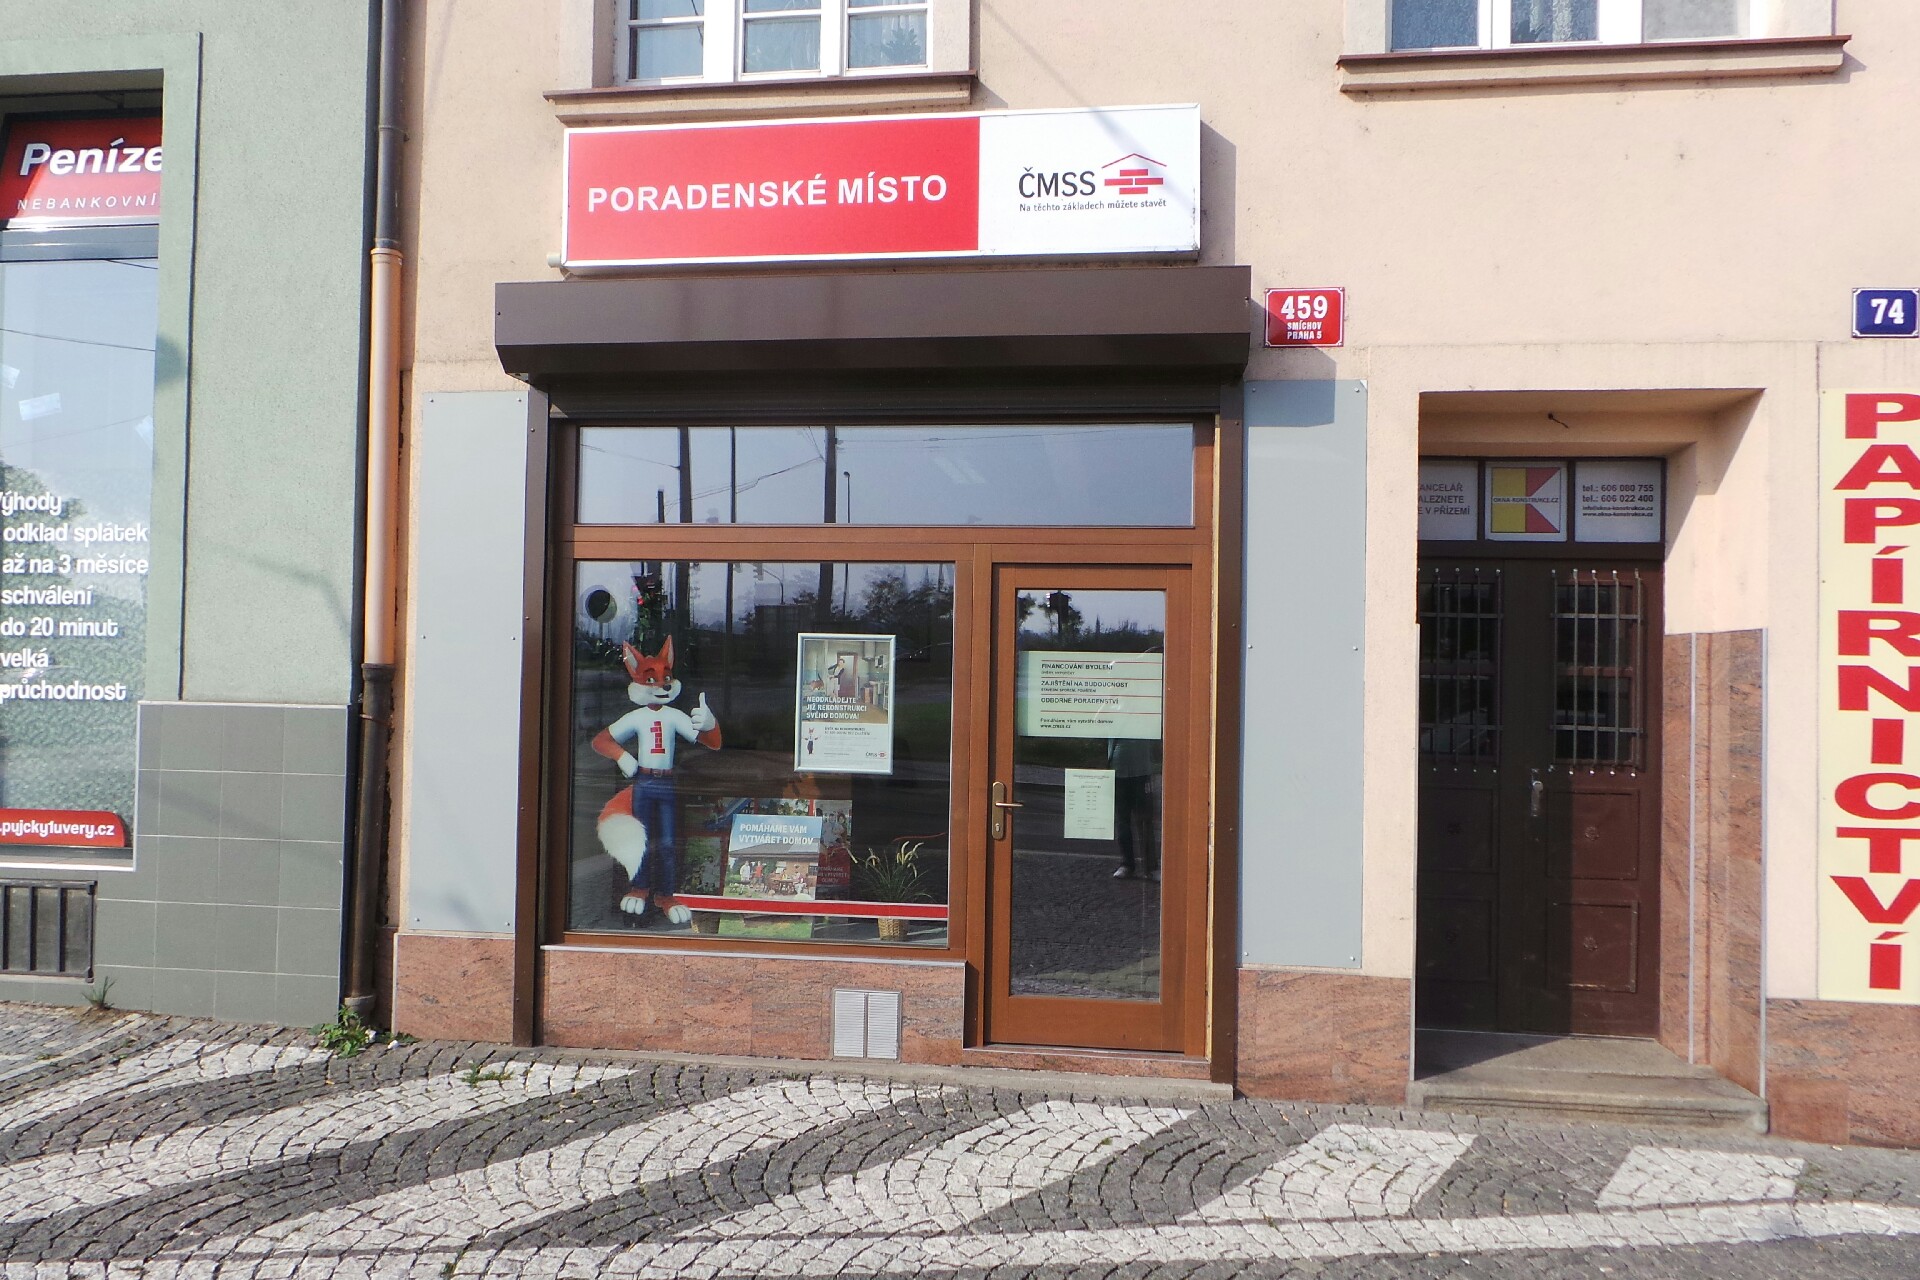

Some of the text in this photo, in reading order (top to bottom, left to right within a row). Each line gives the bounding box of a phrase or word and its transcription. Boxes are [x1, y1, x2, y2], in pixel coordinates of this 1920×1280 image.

[19, 137, 163, 176] Peníze
[588, 171, 948, 212] PORADENSKÉ MÍSTO
[1018, 166, 1096, 198] ČMSS
[17, 192, 157, 211] NEBANKOVNÍ
[1019, 199, 1167, 212] Na těchto základech můžete stavět
[1280, 295, 1328, 320] 459
[1870, 298, 1904, 324] 74
[1287, 320, 1322, 330] SMÍCHOV
[1287, 330, 1322, 340] PRAHA 5
[0, 492, 62, 515] ýhody
[1425, 506, 1432, 515] V
[1433, 505, 1471, 515] PŘÍZEMÍ
[3, 523, 148, 548] odklad splátek
[2, 553, 149, 574] až na 3 měsíce
[1, 585, 93, 606] schválení
[0, 617, 118, 637] do 20 minut
[0, 648, 49, 667] velká
[0, 679, 127, 703] průchodnost
[1830, 393, 1920, 990] PAPÍRNICTVÍ
[782, 836, 813, 845] DOMOV
